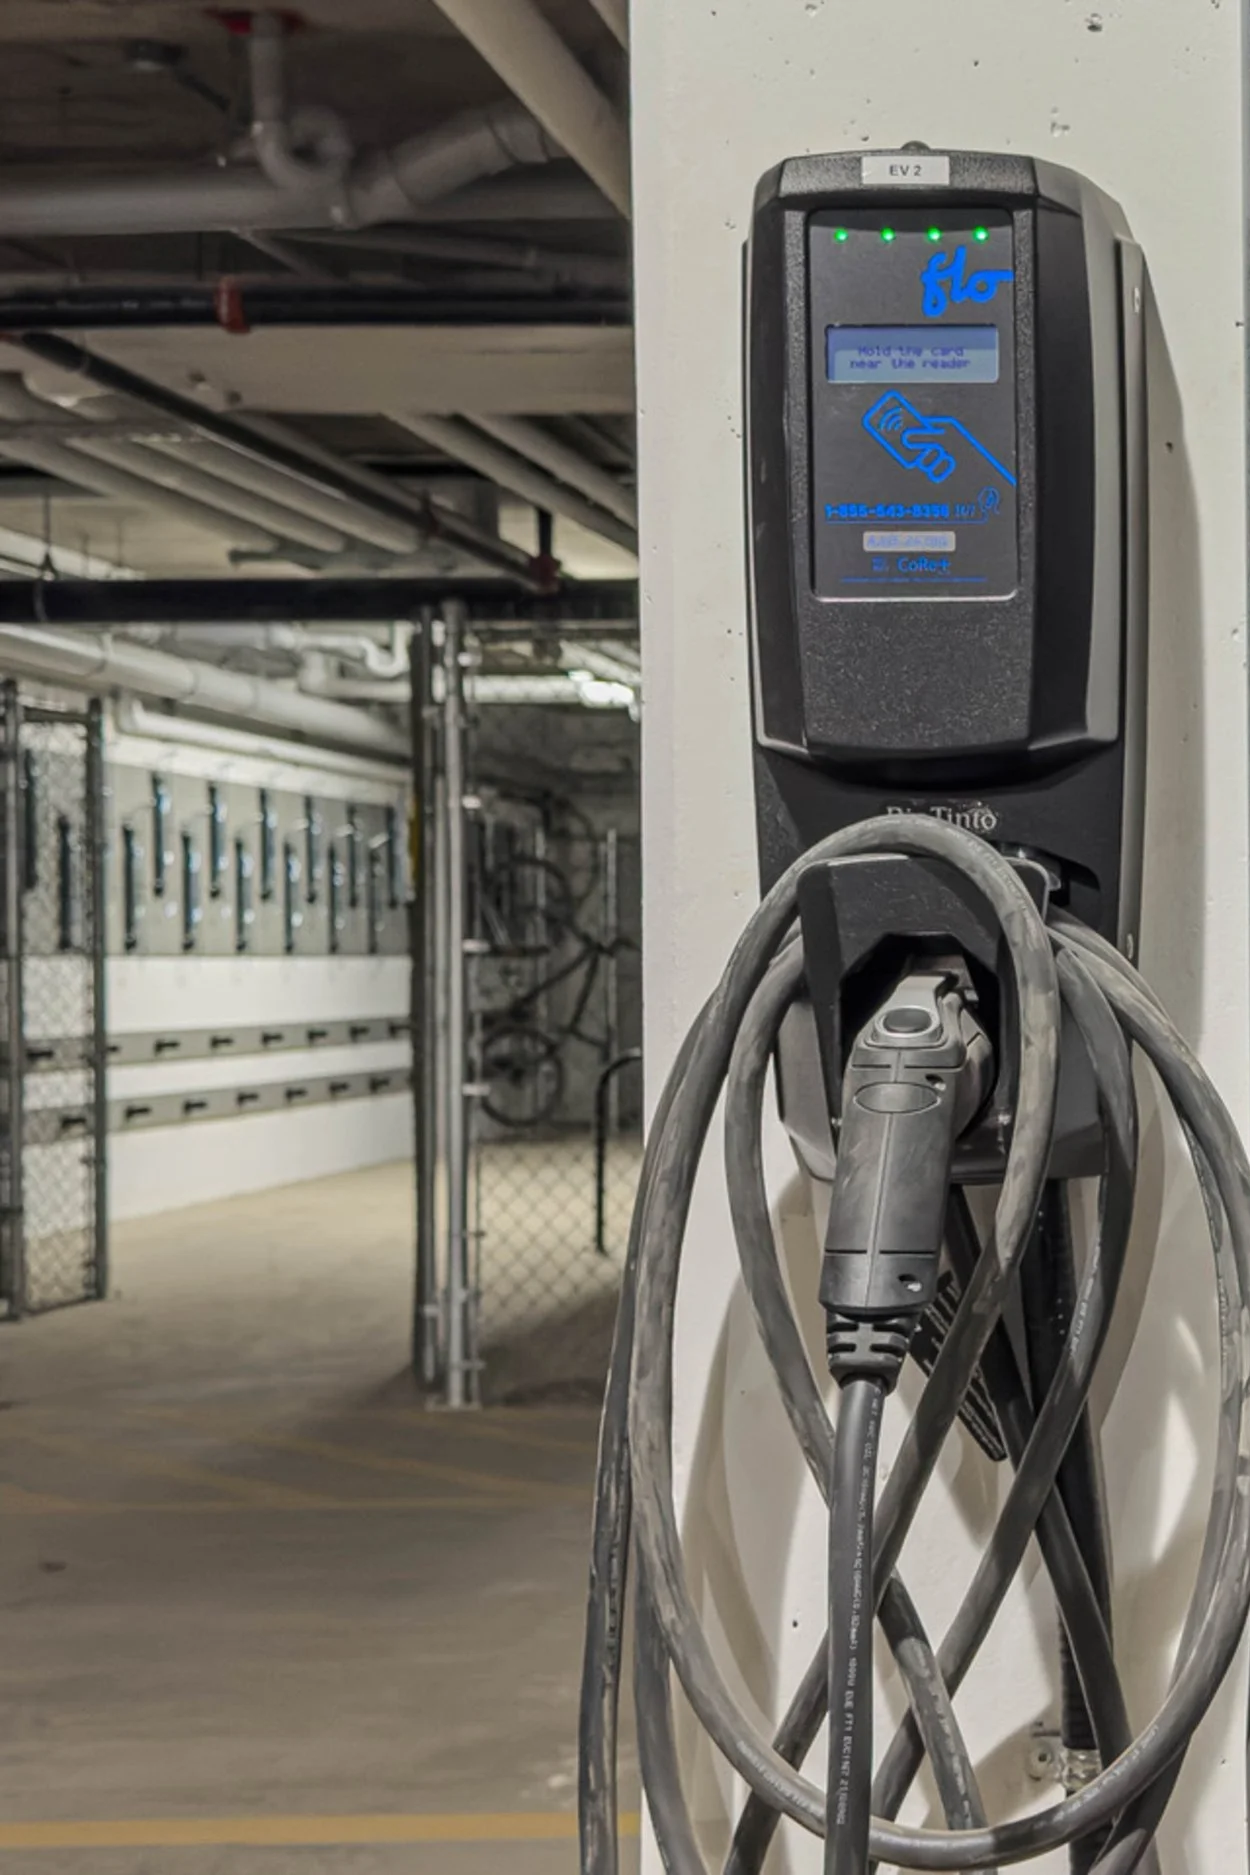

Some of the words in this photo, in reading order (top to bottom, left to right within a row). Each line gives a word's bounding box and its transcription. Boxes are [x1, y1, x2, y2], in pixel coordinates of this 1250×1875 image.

[889, 165, 911, 177] EV
[913, 165, 923, 177] 2
[920, 244, 1015, 318] flo
[858, 345, 891, 357] Hold
[931, 345, 965, 357] card
[850, 359, 882, 369] near
[891, 358, 916, 369] the
[922, 357, 970, 369] reader
[886, 806, 997, 831] Tinto
